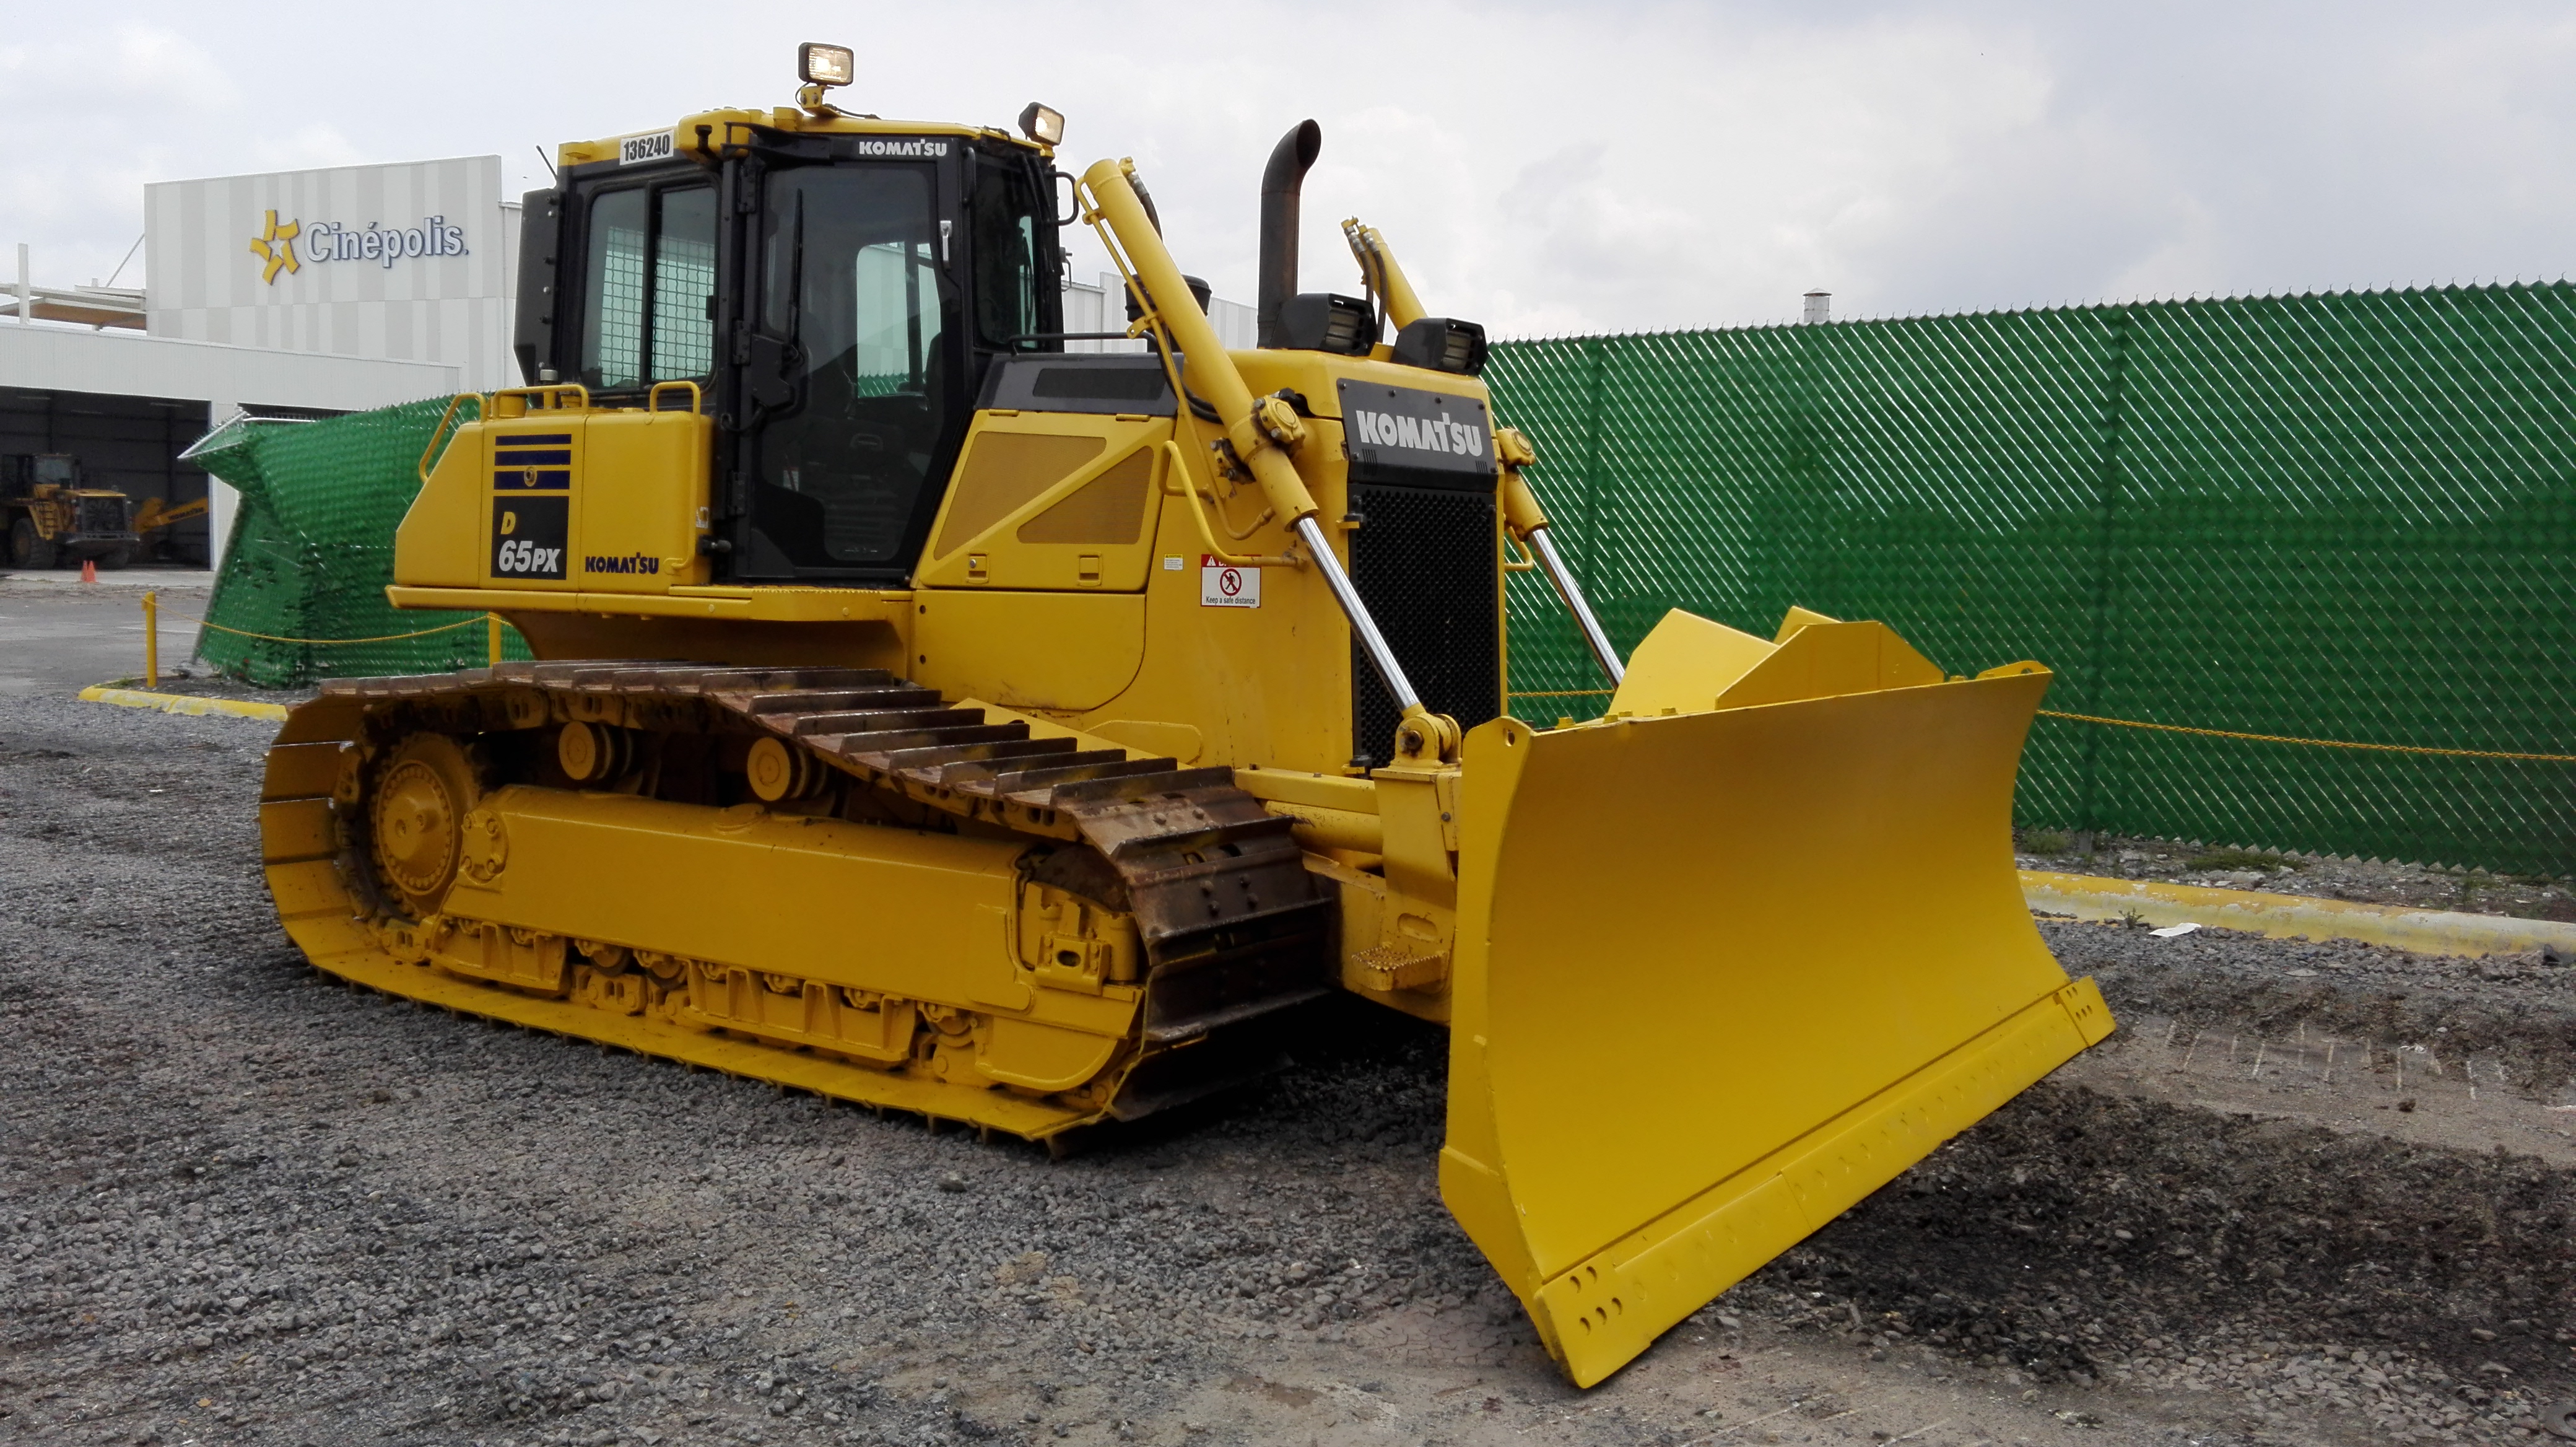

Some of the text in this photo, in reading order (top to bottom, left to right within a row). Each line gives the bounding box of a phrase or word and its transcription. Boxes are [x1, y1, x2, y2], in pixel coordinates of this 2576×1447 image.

[624, 134, 670, 161] 136240
[859, 139, 947, 156] KOMATSU
[1355, 410, 1482, 457] KOMATSU
[500, 511, 516, 535] D
[498, 540, 561, 572] 65PX
[585, 552, 659, 574] KOMATSU
[1206, 596, 1219, 605] Keep
